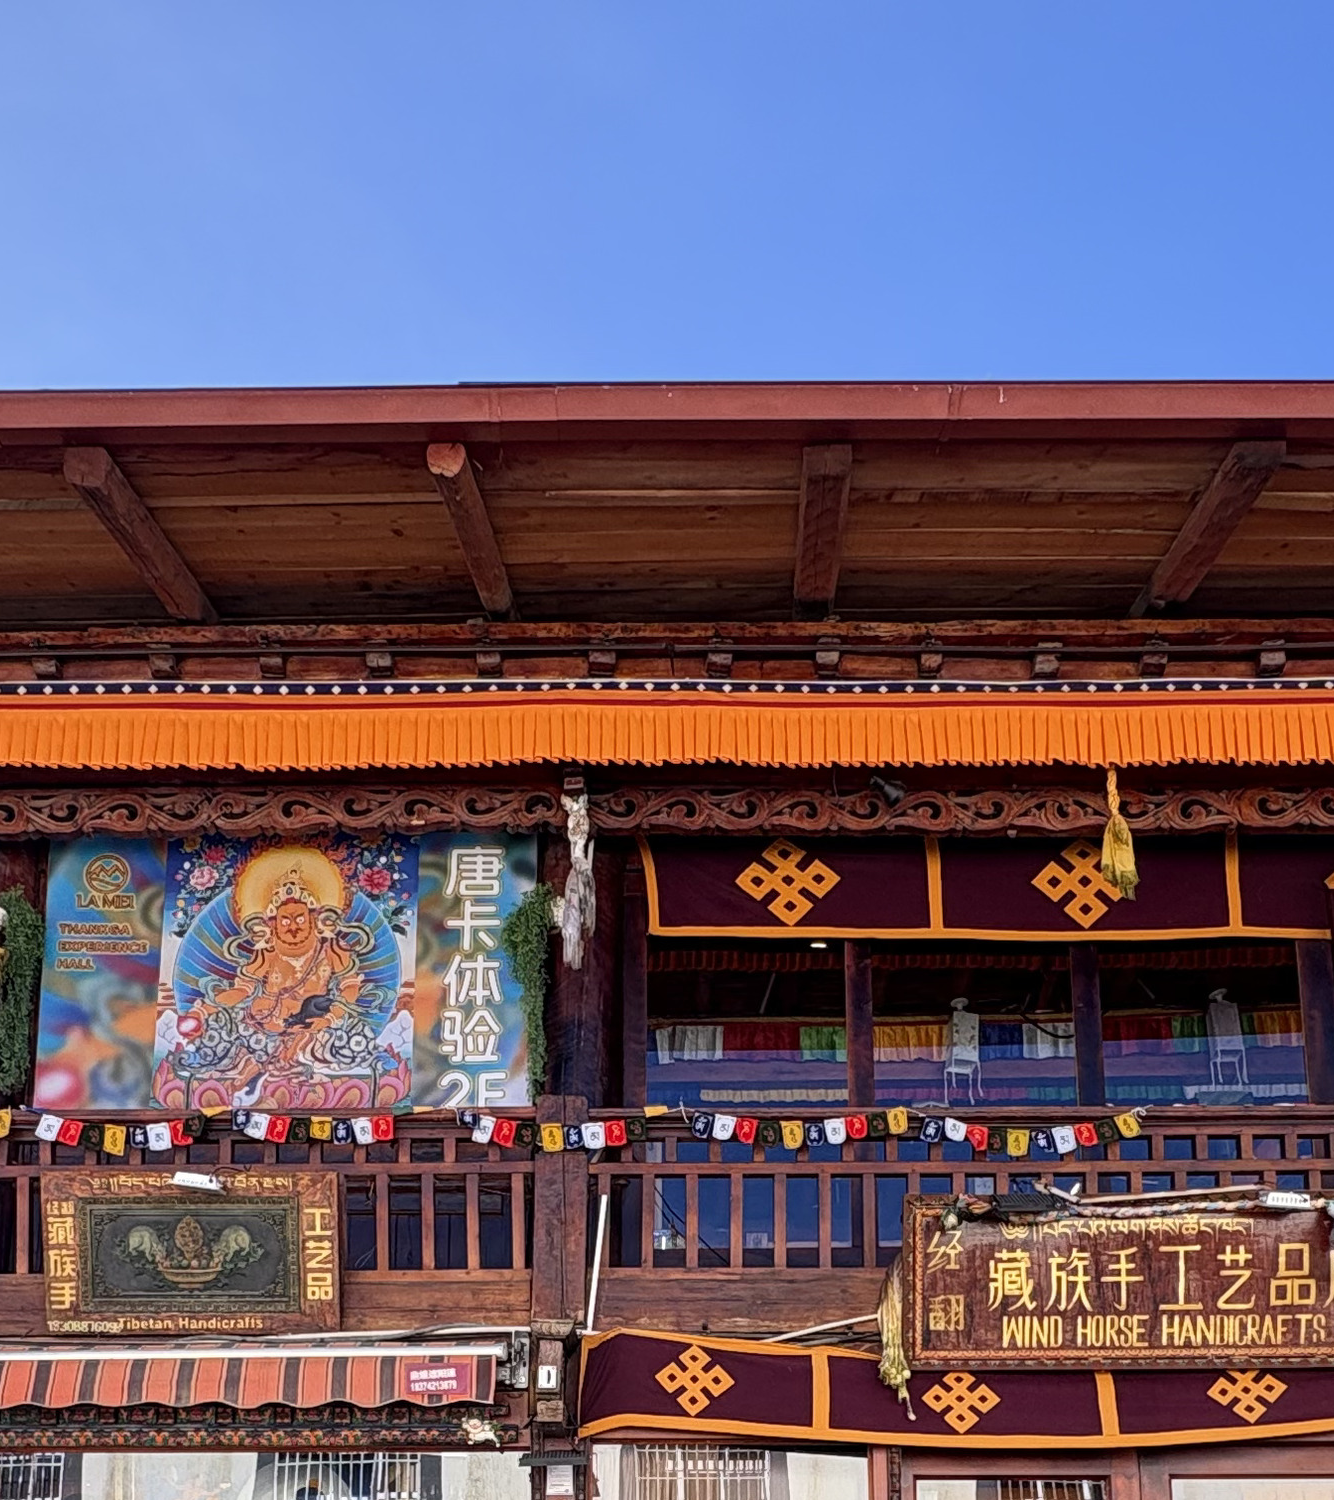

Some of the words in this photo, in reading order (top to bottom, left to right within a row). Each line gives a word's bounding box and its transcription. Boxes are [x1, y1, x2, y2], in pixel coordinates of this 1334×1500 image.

[76, 893, 100, 909] LA
[57, 939, 149, 955] EXPERIENCE
[441, 846, 505, 1064] 唐卡体验
[56, 957, 95, 970] HALL
[47, 1216, 77, 1310] 藏族手
[303, 1206, 334, 1301] 工艺品
[117, 1317, 172, 1331] Tibetan
[178, 1317, 265, 1331] Handicrafts
[1001, 1315, 1064, 1349] WIND
[1077, 1314, 1150, 1348] HORSE
[1161, 1313, 1327, 1347] HANDICRAFTS
